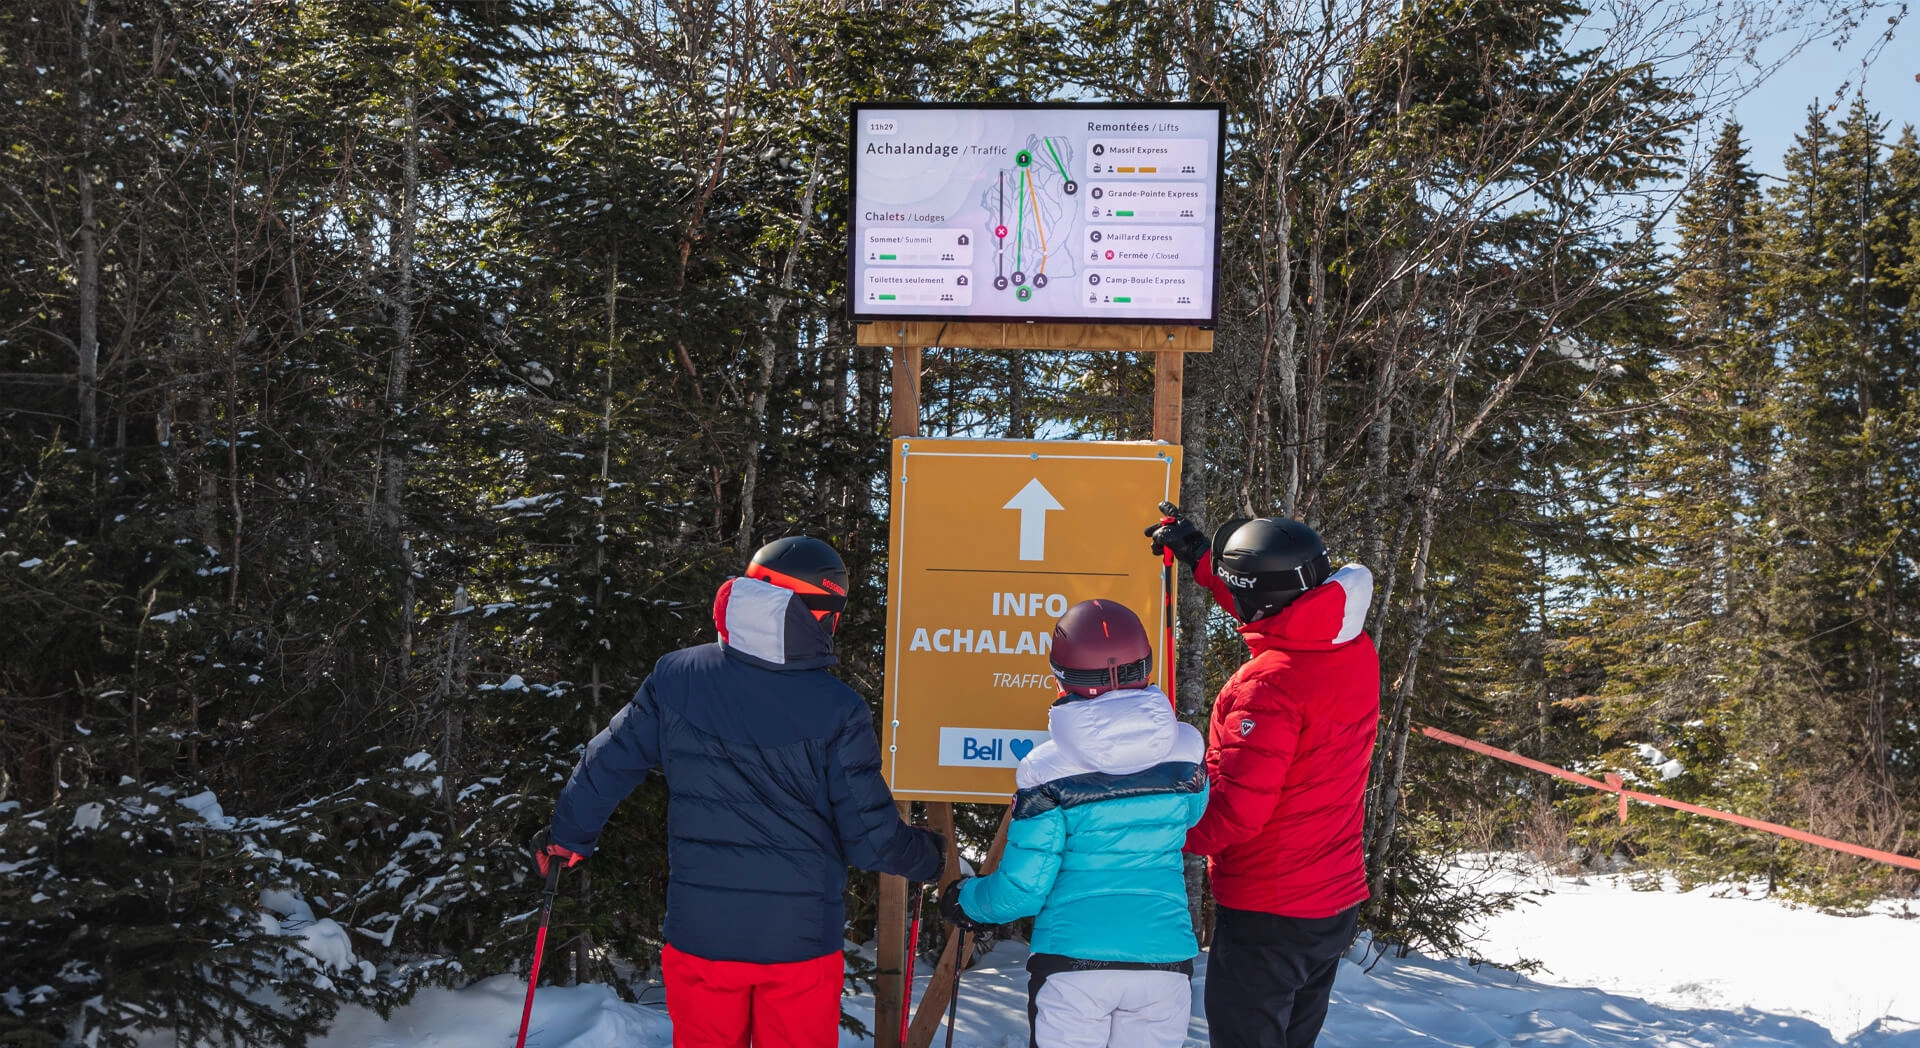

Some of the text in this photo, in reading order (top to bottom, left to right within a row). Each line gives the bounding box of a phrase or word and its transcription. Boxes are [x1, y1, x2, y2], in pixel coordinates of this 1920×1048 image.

[870, 123, 894, 131] 11h29
[1087, 122, 1150, 132] Remontées
[1159, 123, 1180, 132] Lifts
[866, 142, 959, 157] Achalandage
[970, 145, 1007, 155] Traffic
[1109, 146, 1135, 154] Massif
[1137, 147, 1168, 155] Express
[1108, 190, 1165, 198] Grande-Pointe
[1167, 190, 1199, 198] Express
[865, 212, 905, 221] Chalets
[914, 213, 945, 223] Lodges
[905, 236, 932, 244] Summit
[1107, 233, 1140, 241] Maillard
[1142, 234, 1173, 242] Express
[1118, 251, 1149, 259] Fermée
[1155, 252, 1179, 260] Closed
[869, 276, 944, 284] Toilettes seulement
[1105, 276, 1153, 285] Camp-Boule
[1155, 277, 1186, 285] Express
[992, 592, 1068, 618] INFO
[909, 627, 1053, 655] ACHALAN
[992, 672, 1055, 690] TRAFFIC
[963, 737, 1003, 761] Bell
